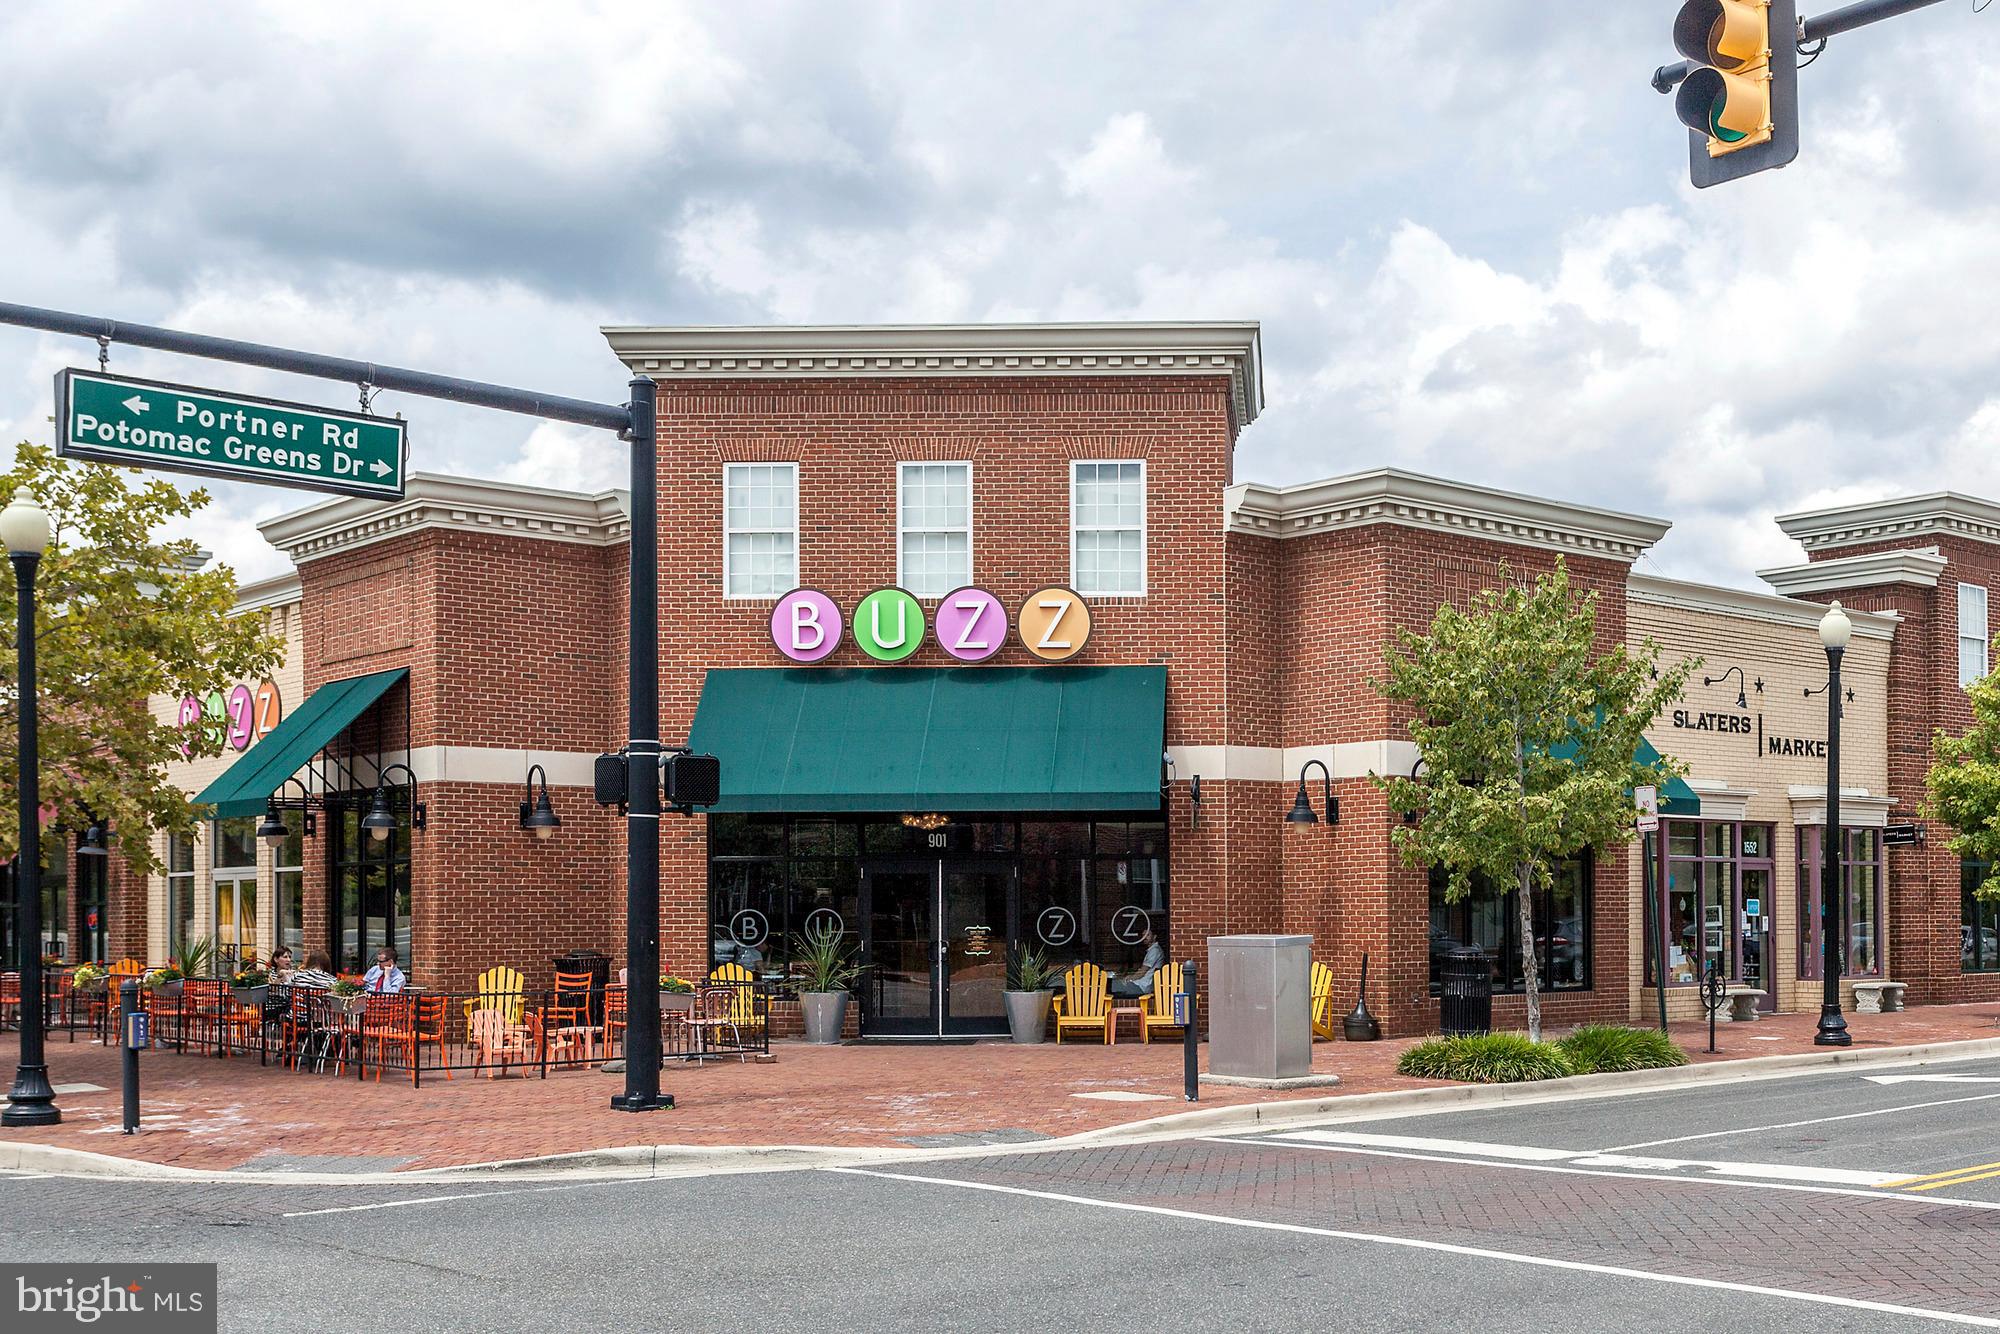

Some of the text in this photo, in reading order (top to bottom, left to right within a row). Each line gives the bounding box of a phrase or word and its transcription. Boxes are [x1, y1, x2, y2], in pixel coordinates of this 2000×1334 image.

[177, 401, 359, 449] Portner Rd
[76, 414, 364, 476] Potomac Greens Dr
[1673, 710, 1751, 734] SLATERS
[1769, 736, 1829, 758] MARKE
[928, 833, 947, 848] 901
[1743, 841, 1757, 854] 1552
